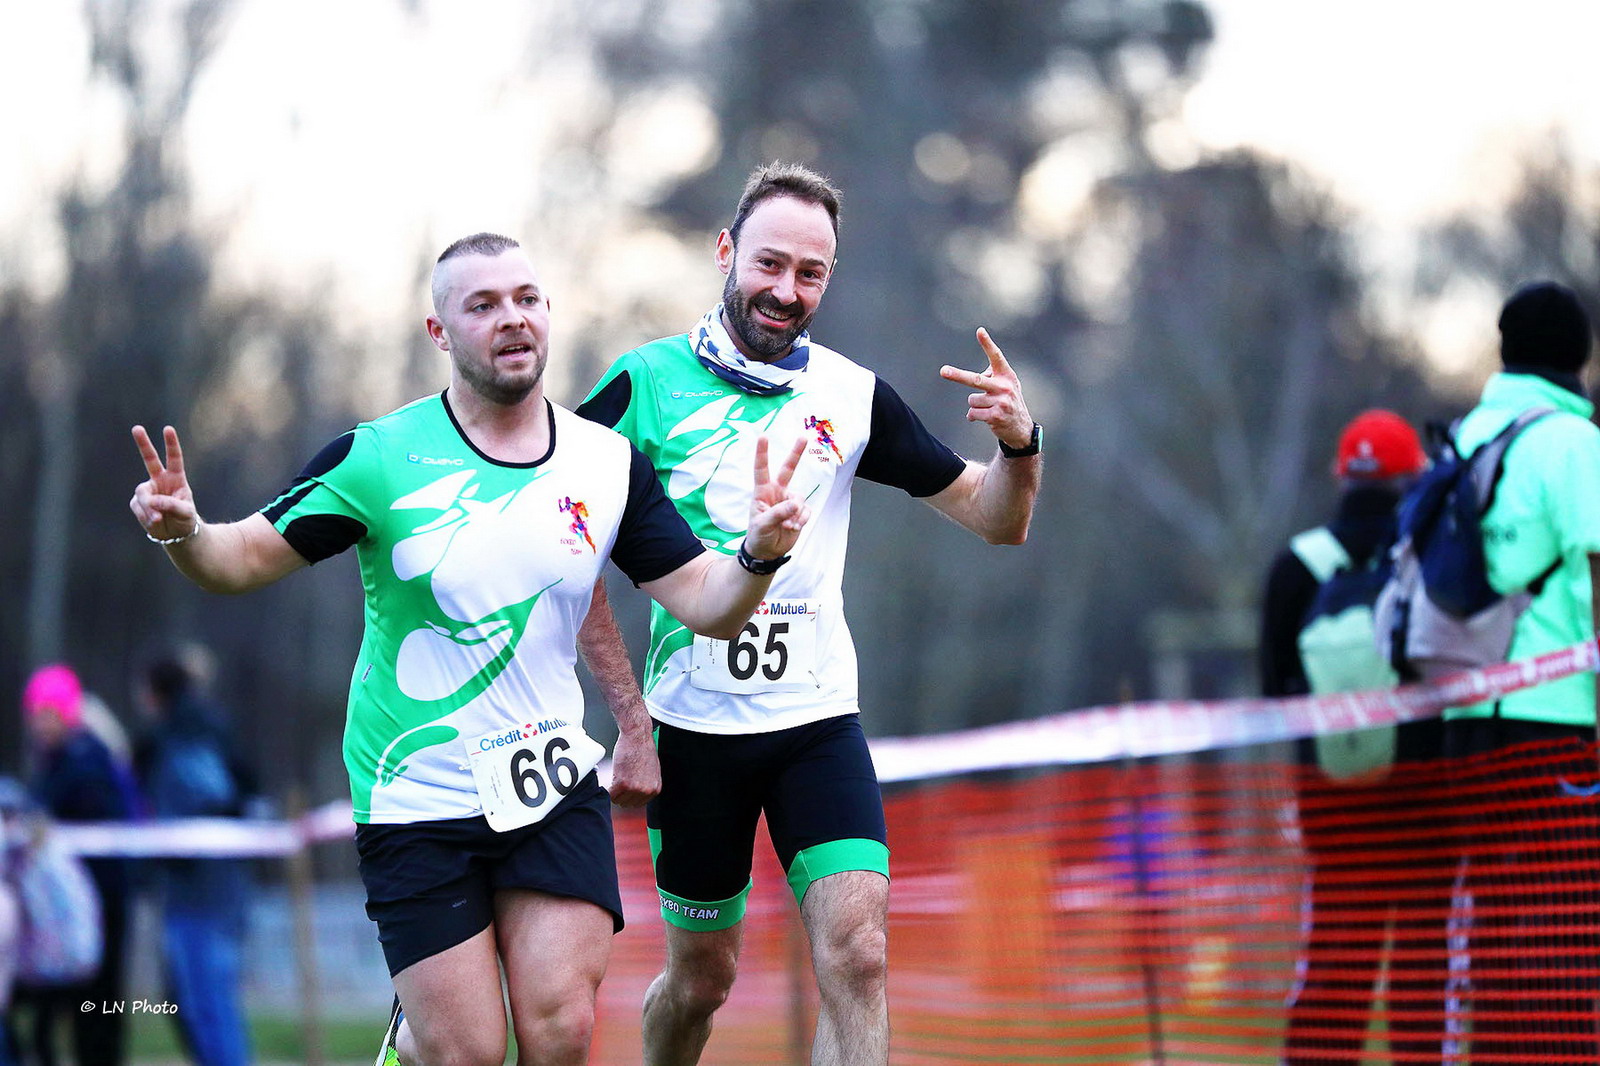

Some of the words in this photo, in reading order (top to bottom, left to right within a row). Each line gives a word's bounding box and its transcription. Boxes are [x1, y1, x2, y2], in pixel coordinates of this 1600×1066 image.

[770, 602, 808, 616] Mutuel
[727, 621, 790, 681] 65
[479, 729, 523, 752] Crédit
[538, 717, 571, 734] Mutu
[510, 737, 579, 808] 66
[682, 905, 719, 920] TEAM
